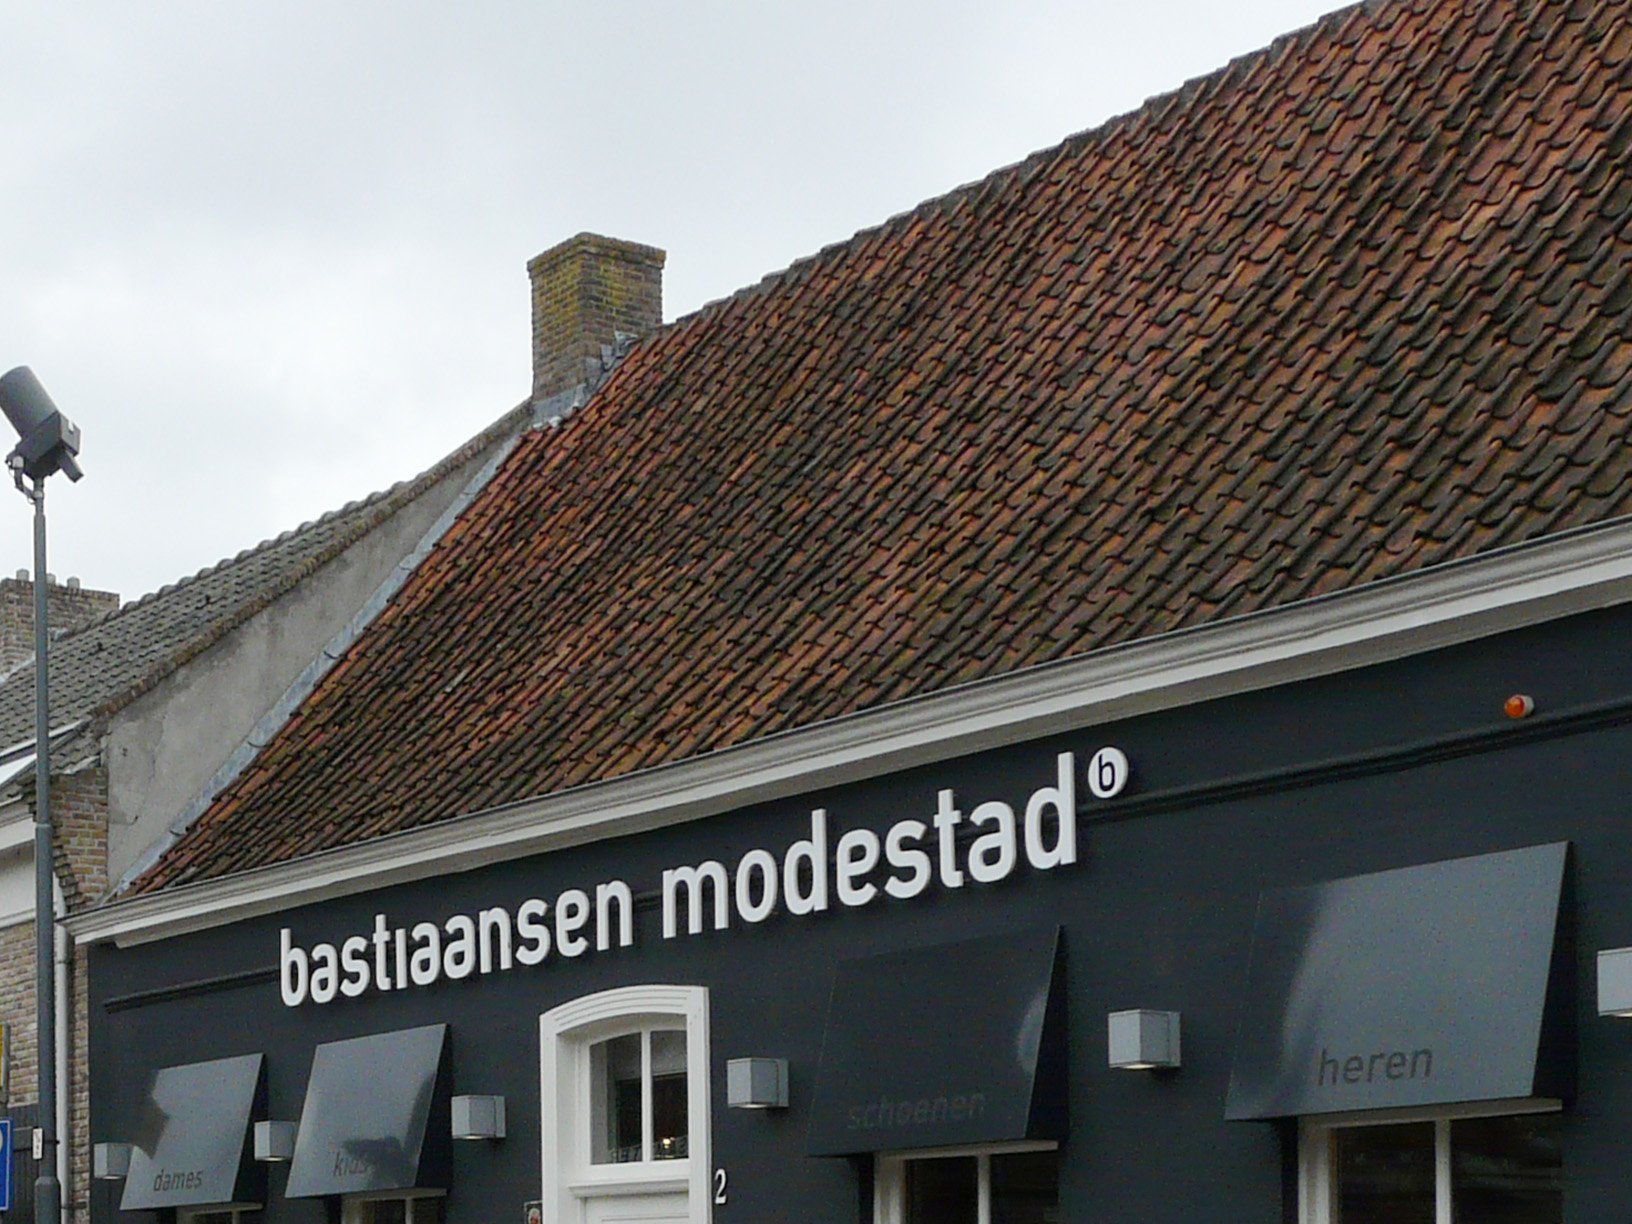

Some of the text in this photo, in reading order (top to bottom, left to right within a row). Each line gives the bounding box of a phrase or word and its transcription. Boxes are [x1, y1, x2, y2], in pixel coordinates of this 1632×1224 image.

[280, 751, 1077, 1007] bastiaansen modestad
[1318, 1047, 1433, 1087] heren
[847, 1093, 986, 1131] schoenen
[153, 1168, 204, 1192] dames
[714, 1168, 727, 1205] 2
